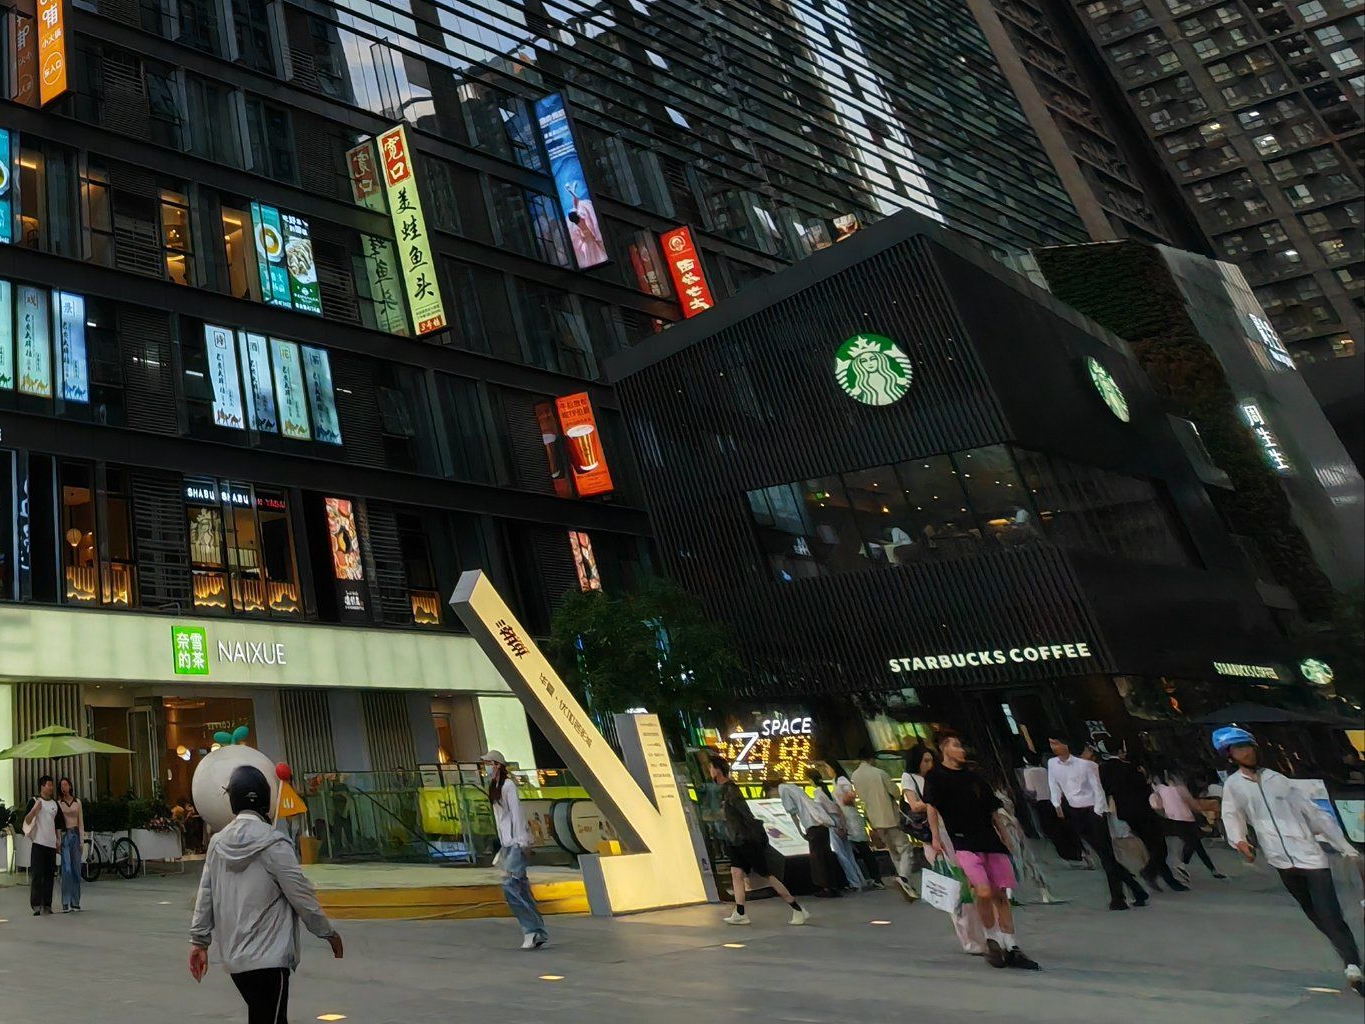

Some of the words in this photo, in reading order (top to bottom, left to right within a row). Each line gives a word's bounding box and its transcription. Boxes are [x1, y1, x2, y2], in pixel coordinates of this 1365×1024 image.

[384, 137, 405, 180] 宽口
[395, 186, 434, 301] 美蛙鱼头
[187, 486, 215, 501] SHABU
[176, 632, 202, 651] 奈雪
[217, 639, 287, 665] NAIXUE
[178, 651, 205, 670] 的茶
[889, 649, 1007, 672] STARBUCKS
[1009, 642, 1092, 664] COFFEE
[761, 717, 813, 737] SPACE
